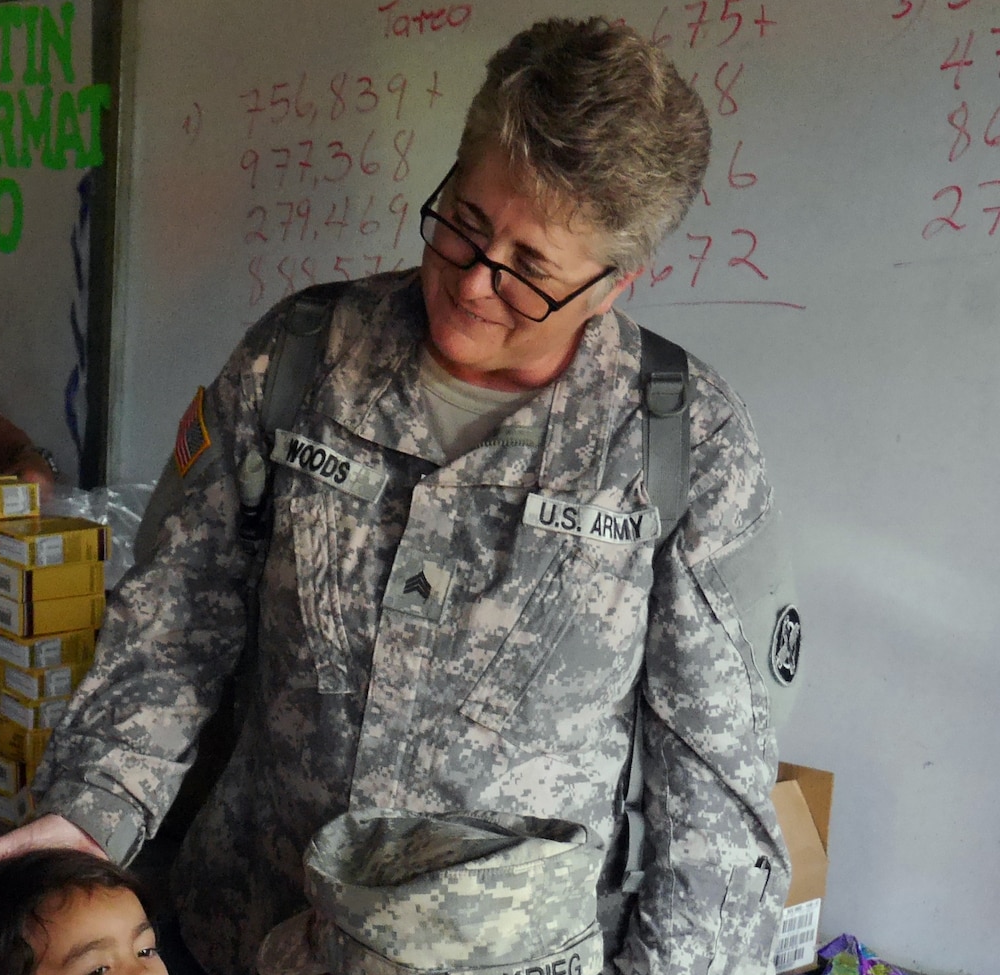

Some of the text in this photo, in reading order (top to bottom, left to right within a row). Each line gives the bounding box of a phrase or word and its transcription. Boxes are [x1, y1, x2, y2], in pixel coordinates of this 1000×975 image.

[240, 130, 415, 189] 977,368
[245, 193, 409, 250] 279,469
[286, 438, 351, 484] WOODS
[539, 500, 643, 541] U.S. ARMY
